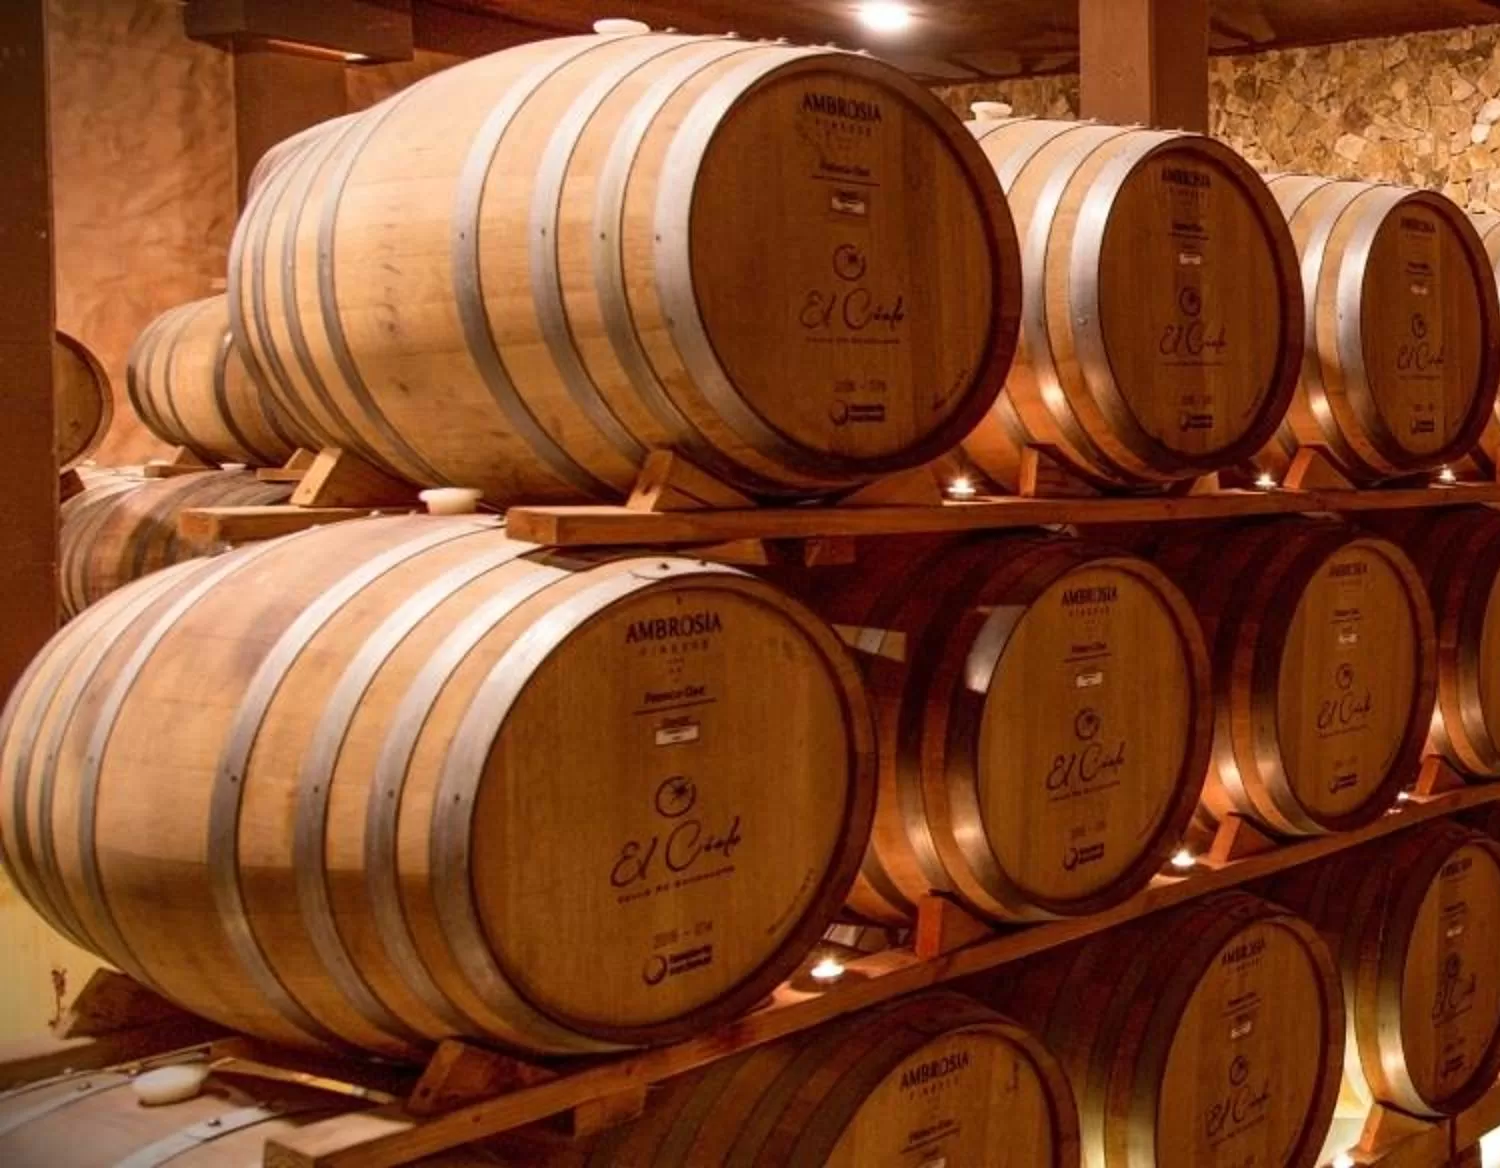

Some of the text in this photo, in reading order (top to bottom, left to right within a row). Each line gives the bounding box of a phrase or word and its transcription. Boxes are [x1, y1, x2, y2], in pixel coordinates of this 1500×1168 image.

[802, 92, 882, 124] AMBROSIA
[800, 289, 837, 329] El
[625, 609, 724, 644] AMBROSIA
[1046, 752, 1077, 790] El
[610, 835, 659, 888] El
[899, 1049, 970, 1092] AMBROSIA
